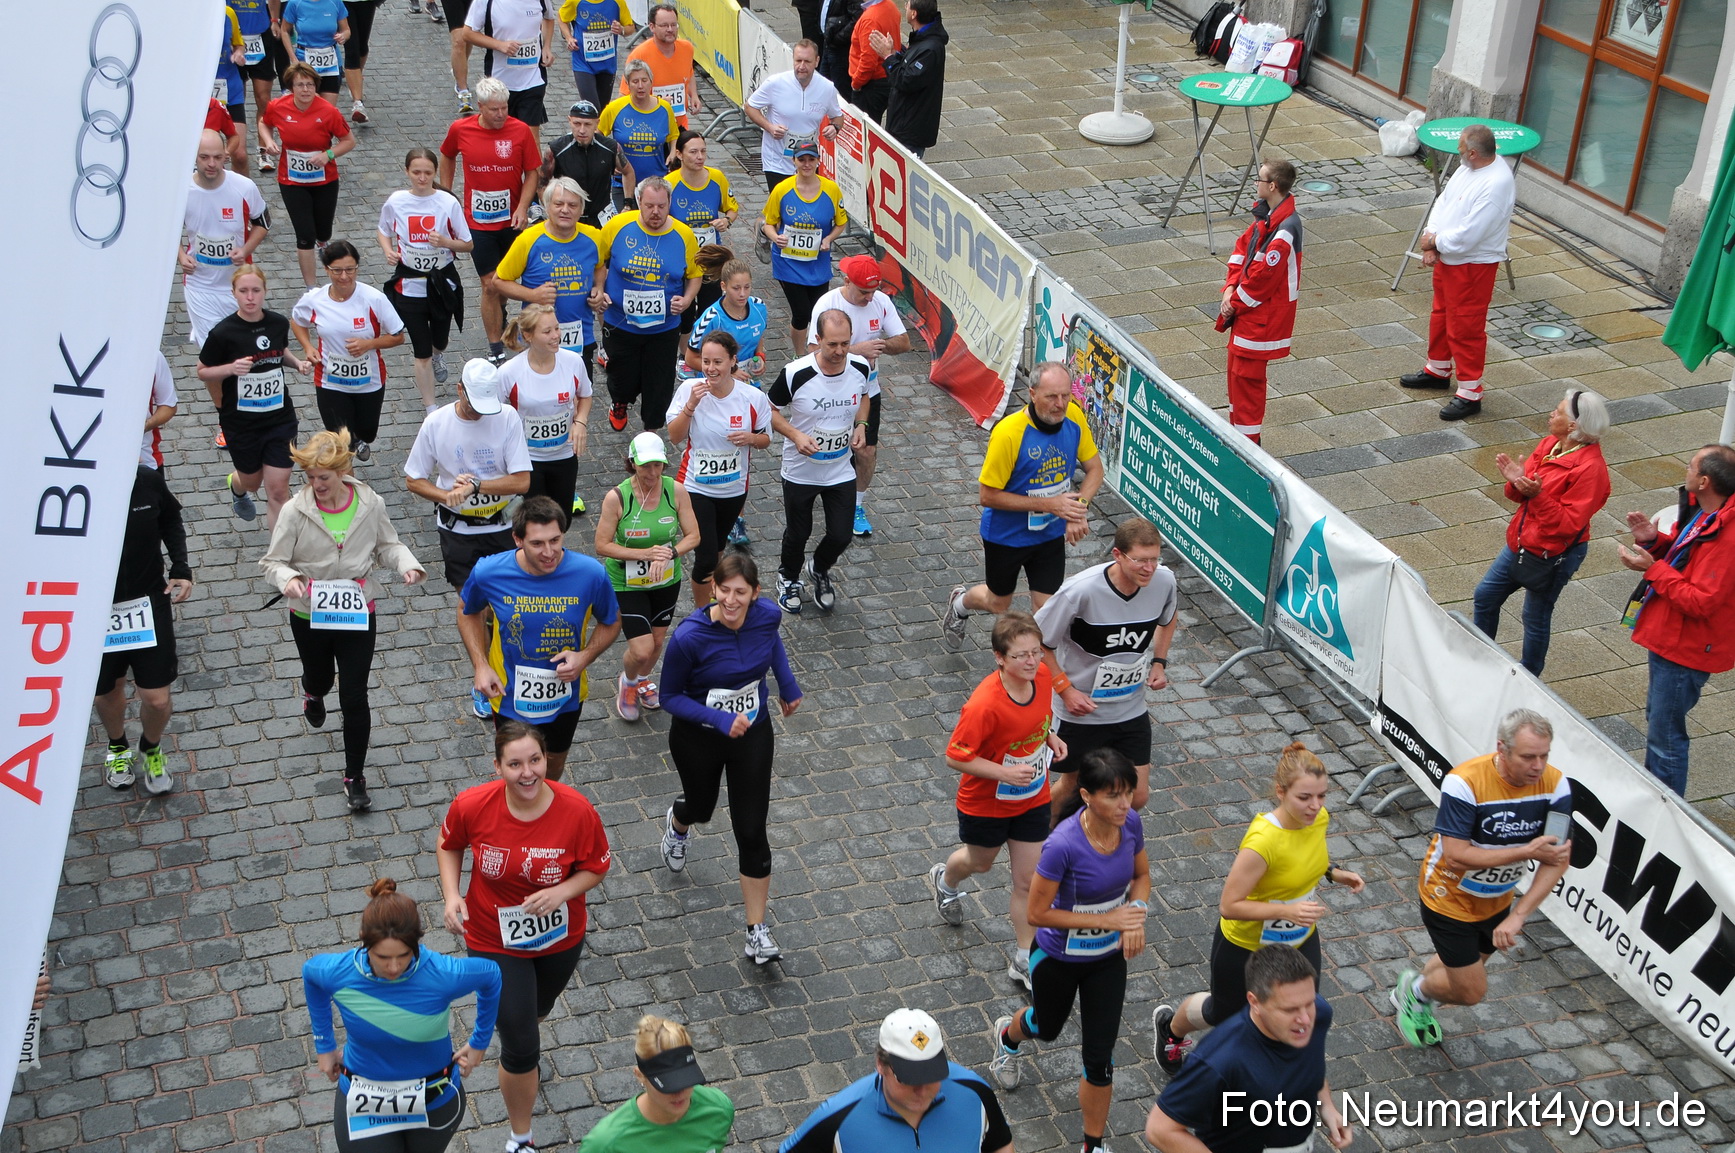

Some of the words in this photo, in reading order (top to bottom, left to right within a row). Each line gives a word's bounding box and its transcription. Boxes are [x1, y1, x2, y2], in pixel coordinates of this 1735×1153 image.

[587, 39, 612, 51] 2241
[309, 55, 335, 66] 2927
[469, 164, 514, 172] Stadt-Team
[476, 198, 507, 211] 2693
[411, 233, 430, 241] DKM
[791, 235, 814, 248] 150
[199, 242, 233, 257] 2903
[628, 300, 662, 314] 3423
[331, 362, 368, 377] 2905
[244, 380, 280, 398] 2482
[34, 332, 110, 537] BKK
[531, 420, 567, 438] 2895
[1151, 399, 1219, 466] Event-Leit-Systeme
[815, 433, 850, 451] 2193
[699, 458, 737, 475] 2944
[1129, 420, 1161, 460] Mehr
[1161, 450, 1220, 516] Sicherheit
[1127, 446, 1144, 474] für
[1146, 463, 1162, 491] Ihr
[1164, 480, 1201, 529] Event!
[475, 507, 498, 516] Roland
[1125, 481, 1140, 504] Miet
[1141, 498, 1148, 511] &
[1148, 504, 1172, 534] Service
[1174, 527, 1190, 551] Line:
[1191, 545, 1213, 572] 09181
[1214, 567, 1233, 591] 6352
[112, 604, 141, 612] Neumarkt
[317, 591, 363, 610] 2485
[503, 596, 515, 605] 10.
[517, 596, 579, 606] NEUMARKTER
[514, 604, 567, 613] STADTLAUF
[107, 610, 146, 632] 311
[324, 614, 355, 622] Melanie
[109, 633, 141, 645] Andreas
[1105, 627, 1148, 649] sky
[1279, 614, 1308, 641] Gebäude
[1309, 634, 1333, 660] Service
[1333, 655, 1355, 677] GmbH
[516, 670, 536, 679] PARTL
[1100, 668, 1142, 688] 2445
[0, 581, 79, 806] Audi
[521, 680, 567, 699] 2384
[527, 701, 560, 711] Christian
[713, 691, 754, 713] 2385
[1427, 755, 1443, 779] die
[1492, 819, 1543, 833] Fischer
[483, 849, 504, 859] IMMER
[528, 852, 559, 860] STADTLAUF
[482, 861, 501, 871] NEU
[1471, 866, 1524, 883] 2565
[508, 909, 563, 941] 2306
[352, 1081, 376, 1092] PARTL
[355, 1093, 418, 1113] 2717
[368, 1115, 407, 1126] Daniela
